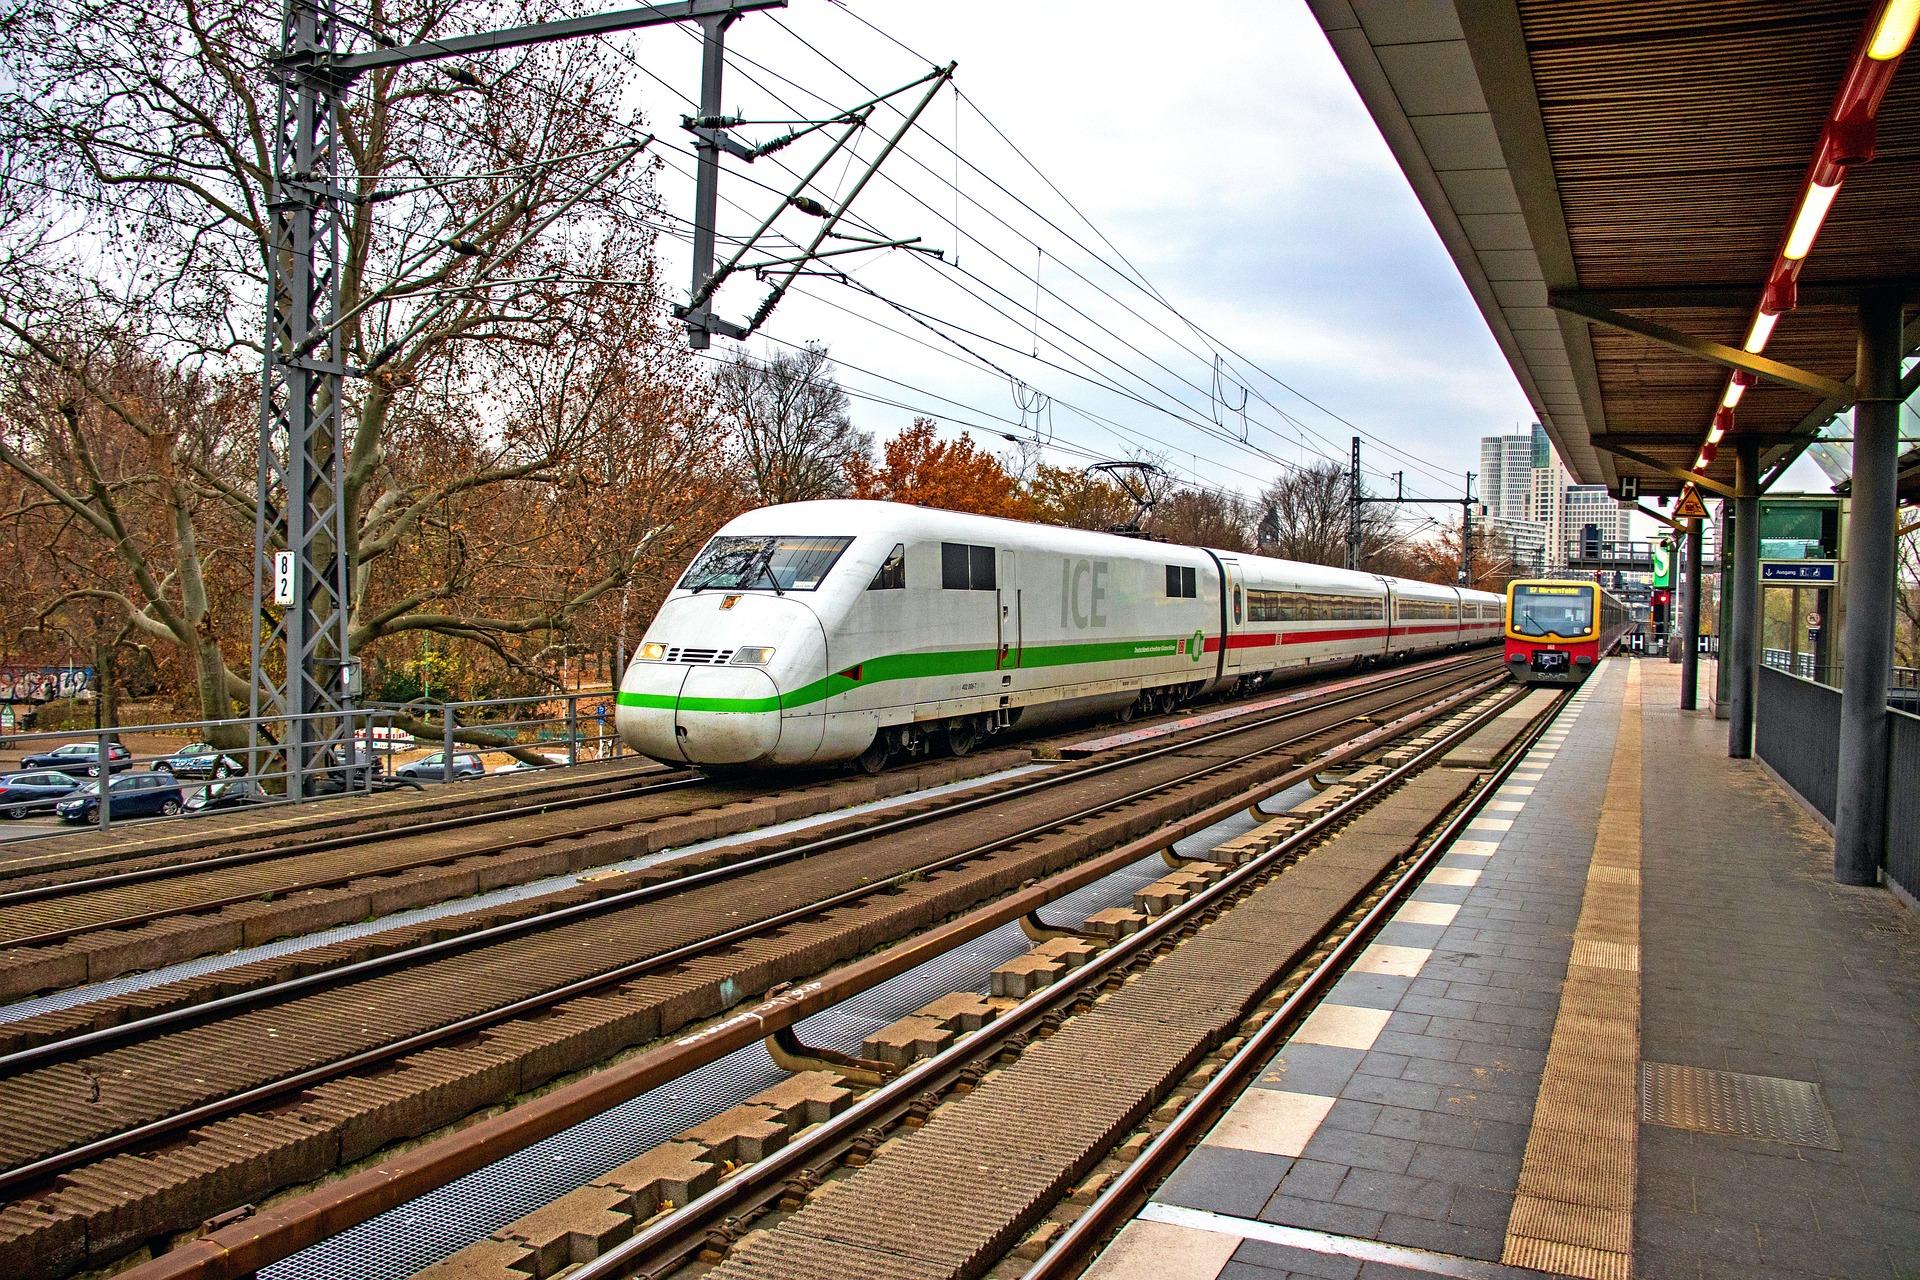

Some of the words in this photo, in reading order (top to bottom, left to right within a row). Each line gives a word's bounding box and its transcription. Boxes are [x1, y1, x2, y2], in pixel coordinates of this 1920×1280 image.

[1622, 477, 1637, 497] H
[281, 556, 288, 574] 8
[1655, 542, 1669, 577] S
[281, 578, 288, 596] 2
[1060, 558, 1108, 629] ICE
[1631, 634, 1644, 650] H
[1698, 636, 1709, 652] H
